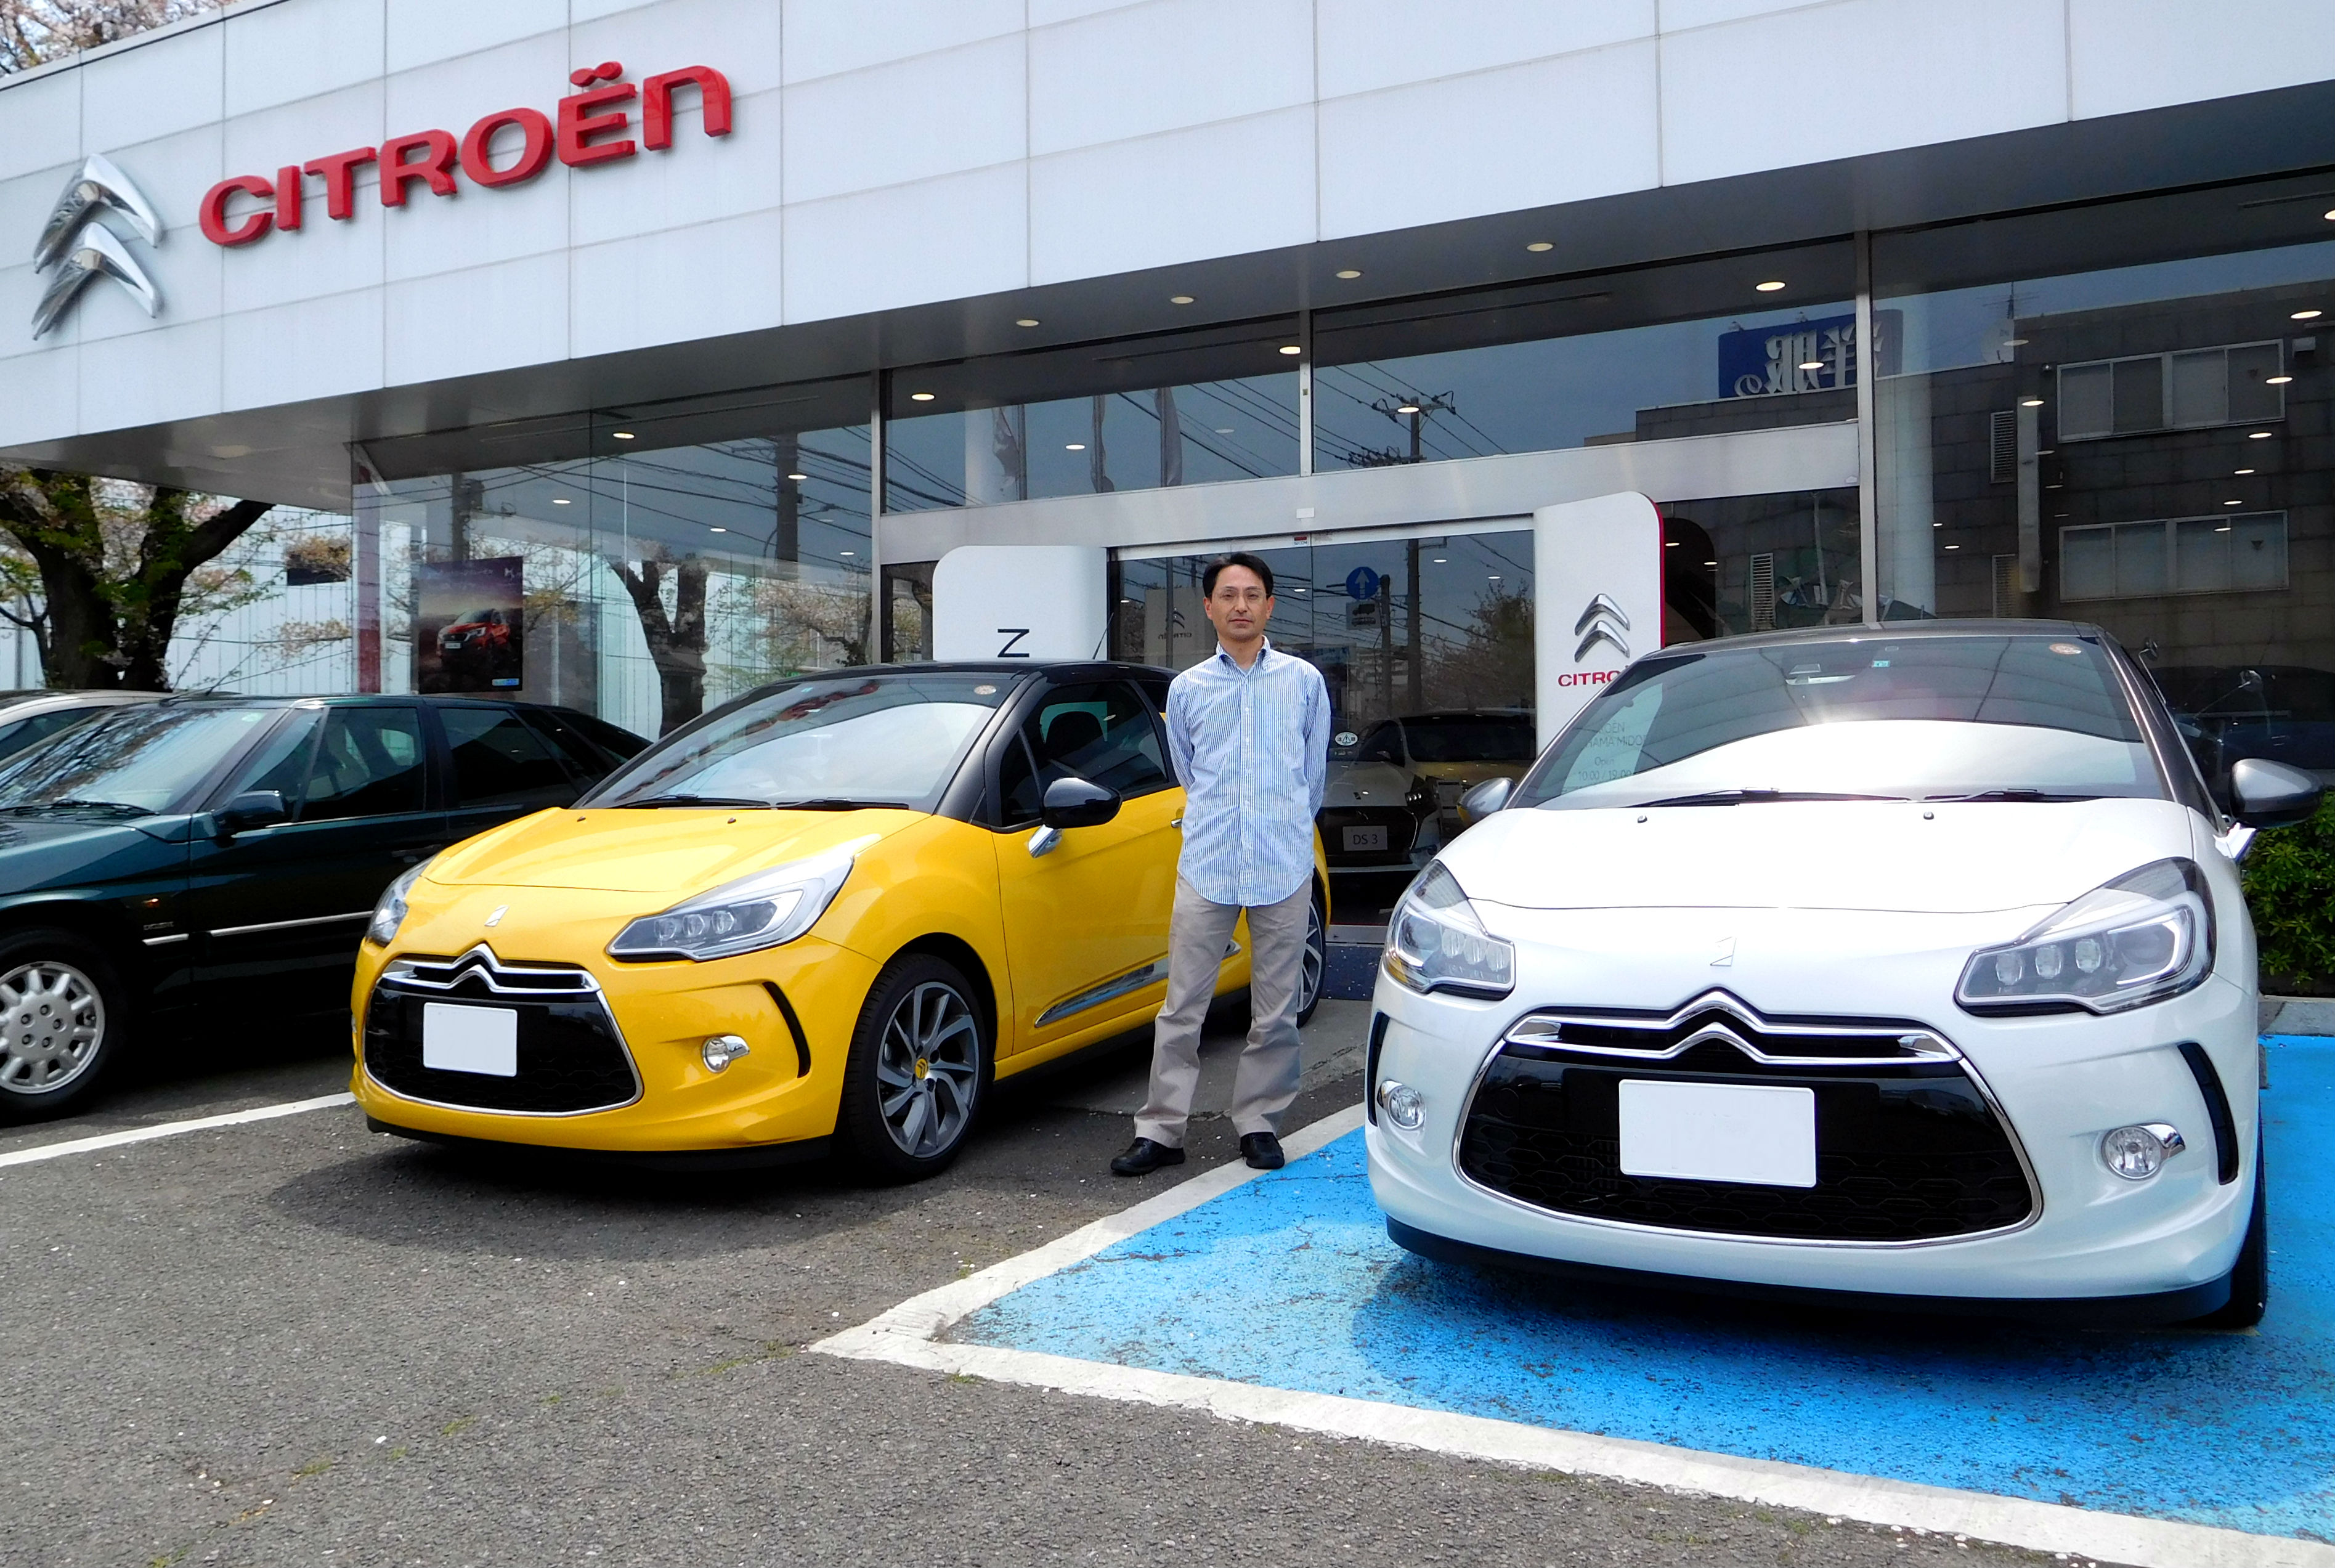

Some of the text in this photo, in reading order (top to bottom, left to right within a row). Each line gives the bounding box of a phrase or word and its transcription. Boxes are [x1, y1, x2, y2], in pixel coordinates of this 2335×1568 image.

[198, 60, 732, 248] CITROËN
[1557, 665, 1629, 687] CITRO
[1352, 834, 1378, 845] DS 3
